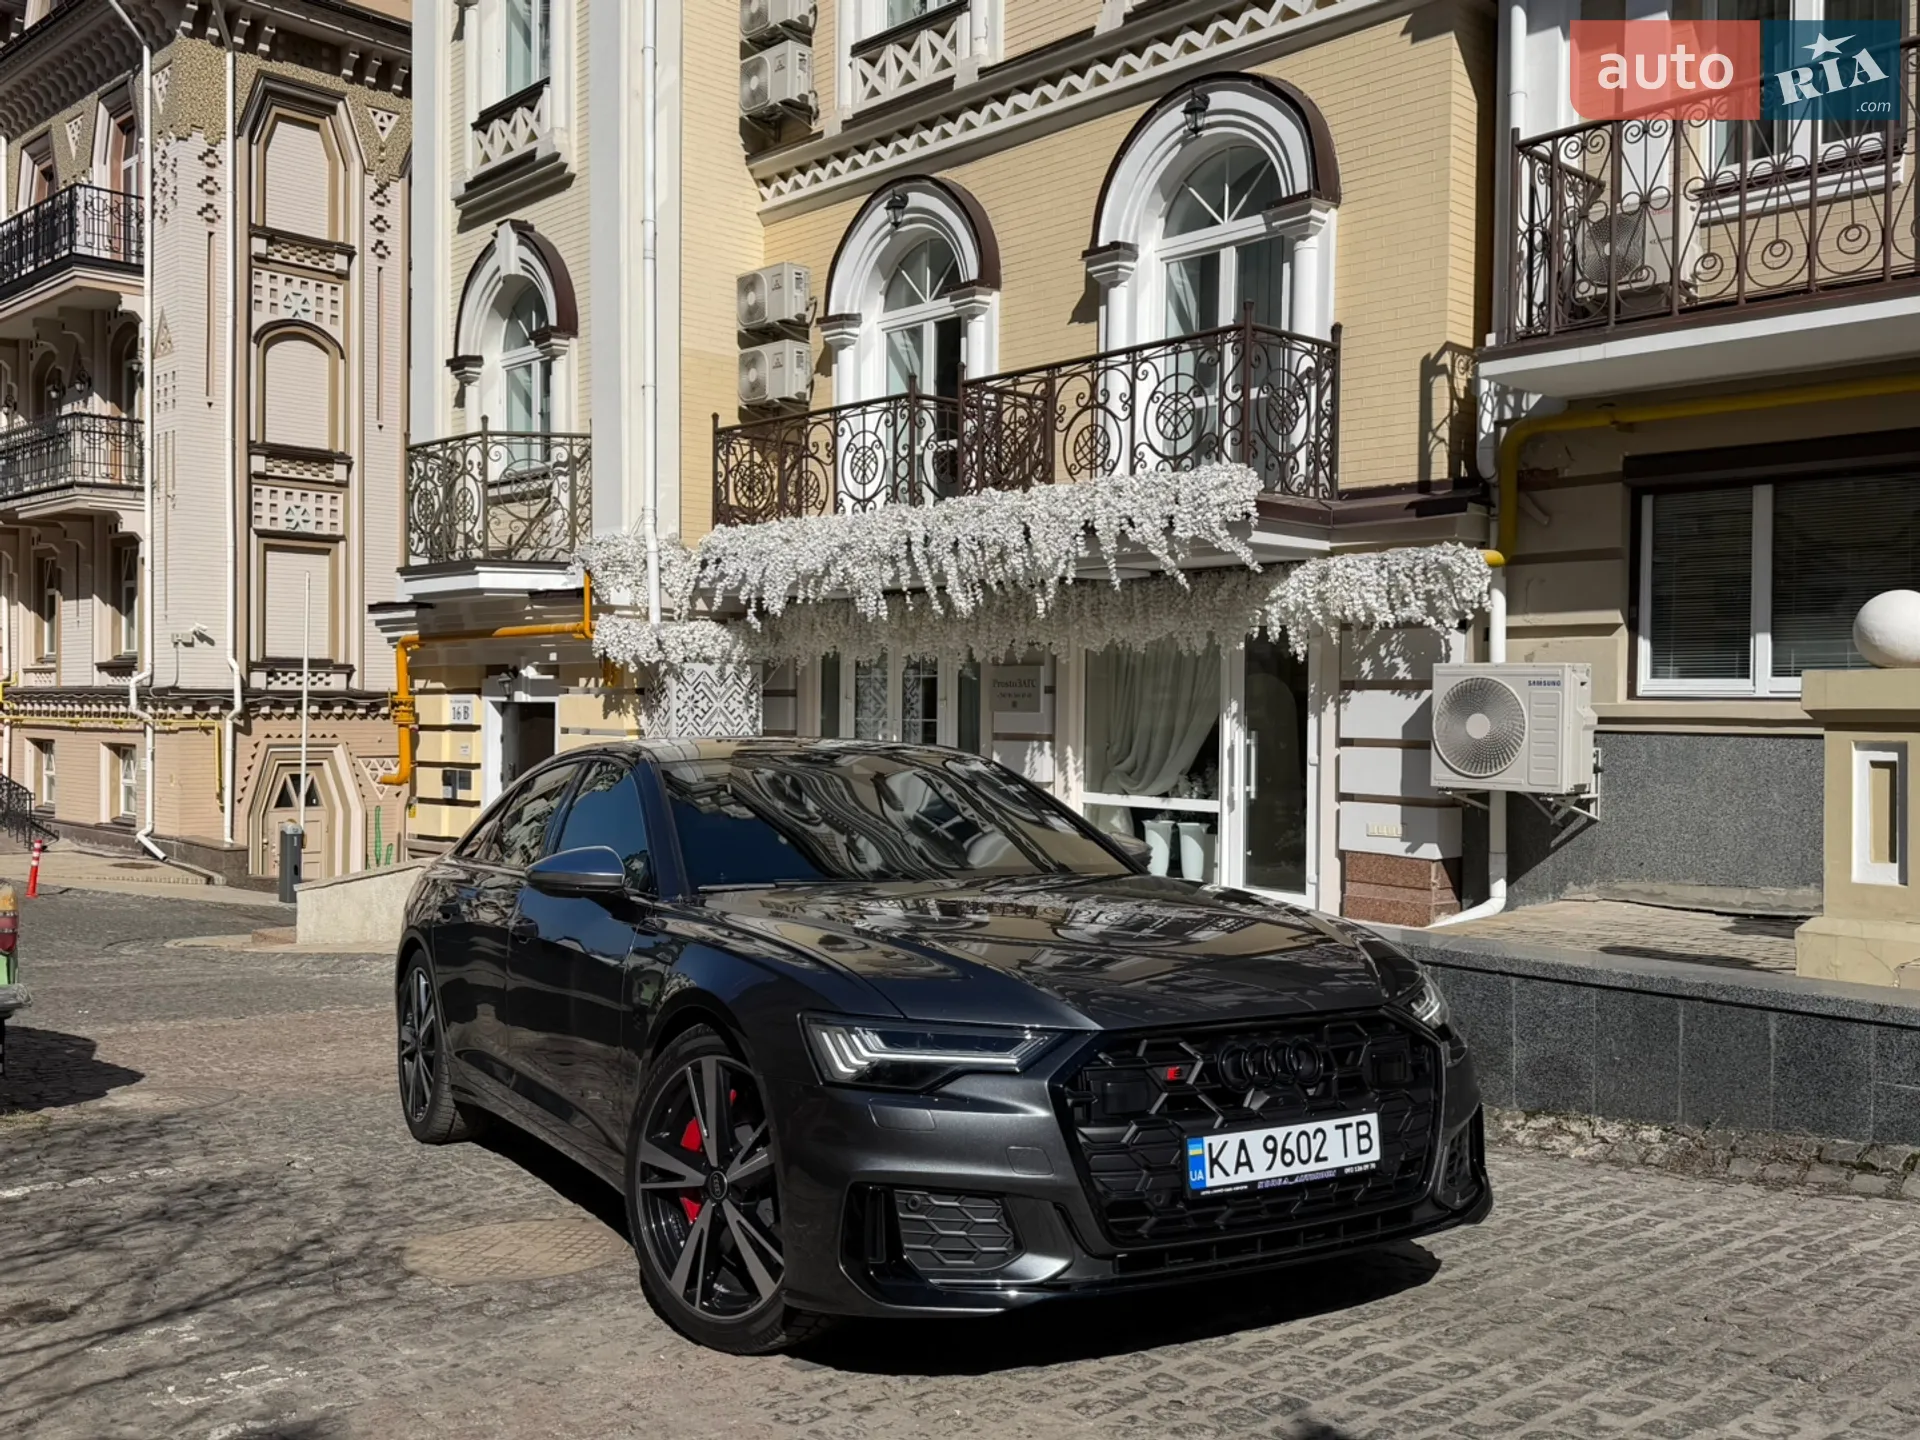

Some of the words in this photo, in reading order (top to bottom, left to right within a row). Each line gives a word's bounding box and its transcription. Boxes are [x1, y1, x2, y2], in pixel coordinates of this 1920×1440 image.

[1207, 1138, 1254, 1179] KA
[1262, 1127, 1328, 1171] 9602
[1335, 1120, 1374, 1159] TB
[1189, 1169, 1204, 1181] UA
